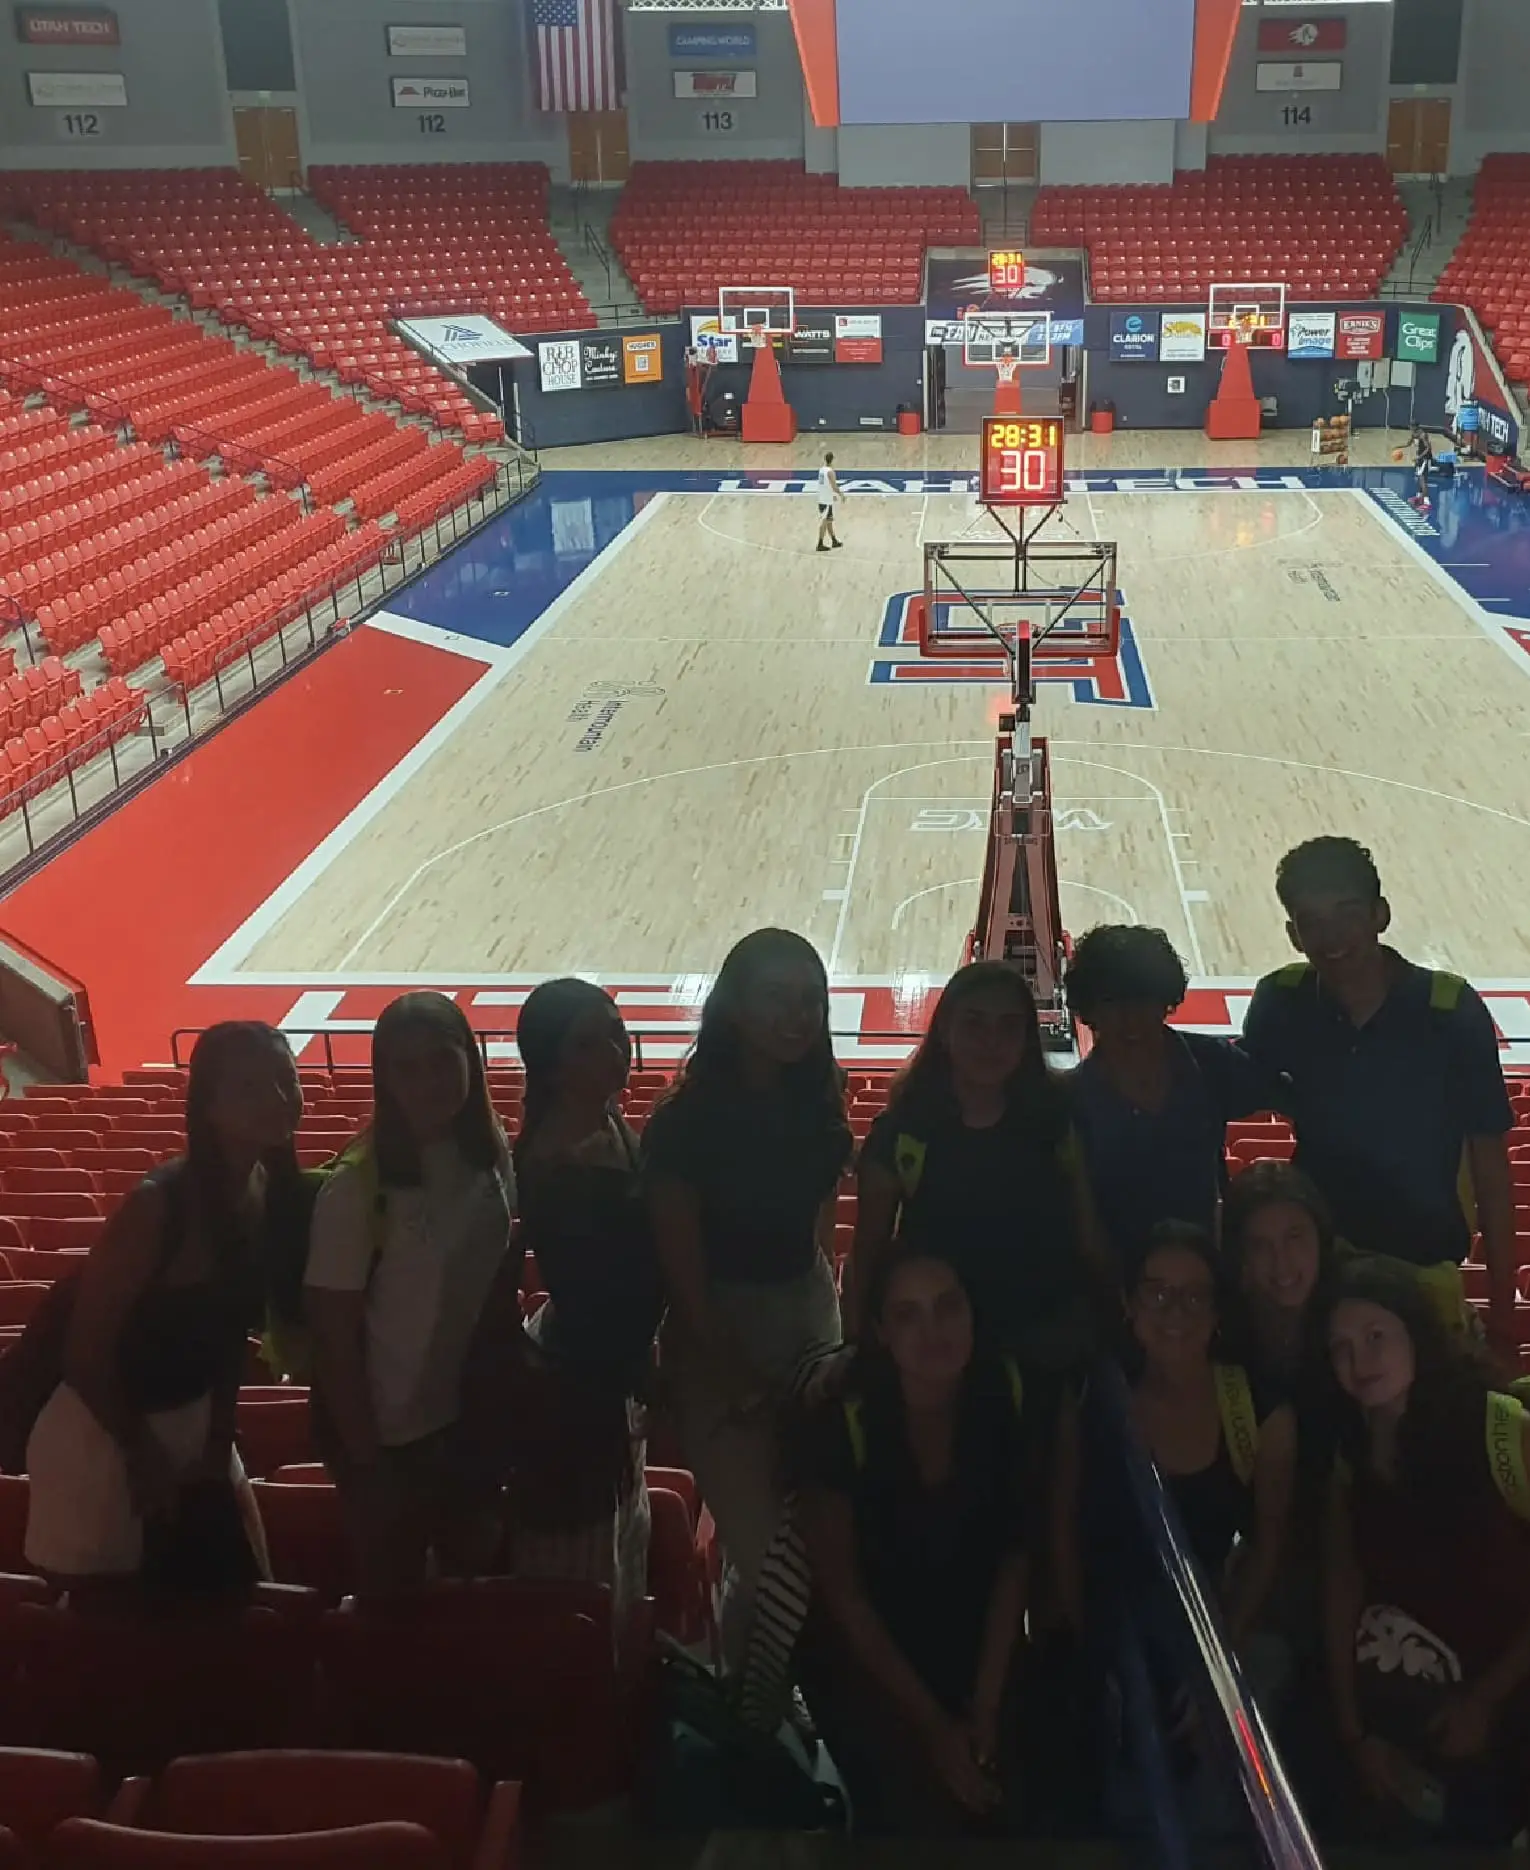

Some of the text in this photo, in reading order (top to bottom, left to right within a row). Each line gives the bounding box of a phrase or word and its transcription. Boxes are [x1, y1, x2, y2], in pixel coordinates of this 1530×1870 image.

[29, 20, 110, 35] UTAH TECH
[63, 114, 100, 136] 112
[417, 114, 447, 133] 112
[702, 111, 734, 130] 113
[1281, 105, 1312, 126] 114
[994, 265, 1018, 284] 30
[697, 334, 732, 349] Star
[1113, 333, 1155, 343] CLARION
[990, 424, 1057, 449] 28:31
[1000, 450, 1046, 490] 30
[572, 700, 630, 753] Intermountain
